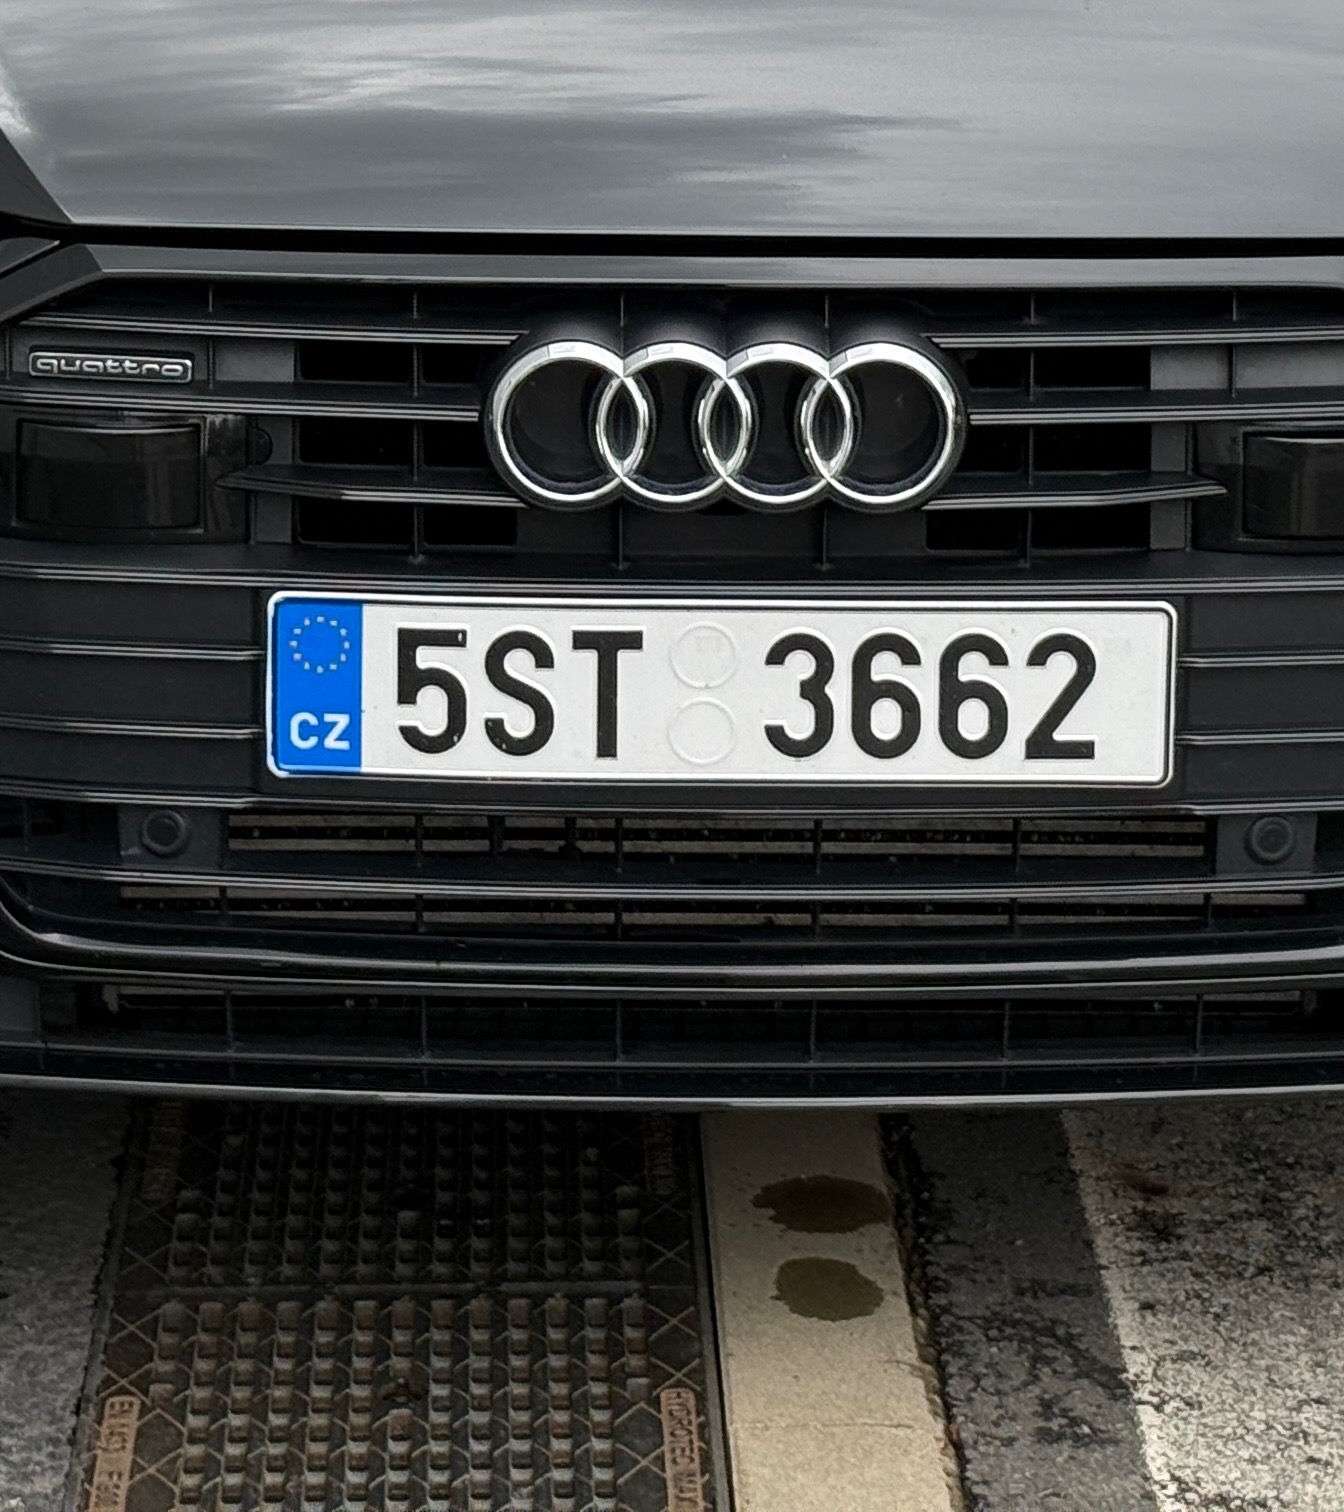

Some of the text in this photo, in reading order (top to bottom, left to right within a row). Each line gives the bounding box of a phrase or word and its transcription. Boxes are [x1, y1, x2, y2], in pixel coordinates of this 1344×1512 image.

[36, 358, 184, 377] quattro
[397, 629, 1096, 761] 5ST 3662
[290, 712, 351, 750] CZ
